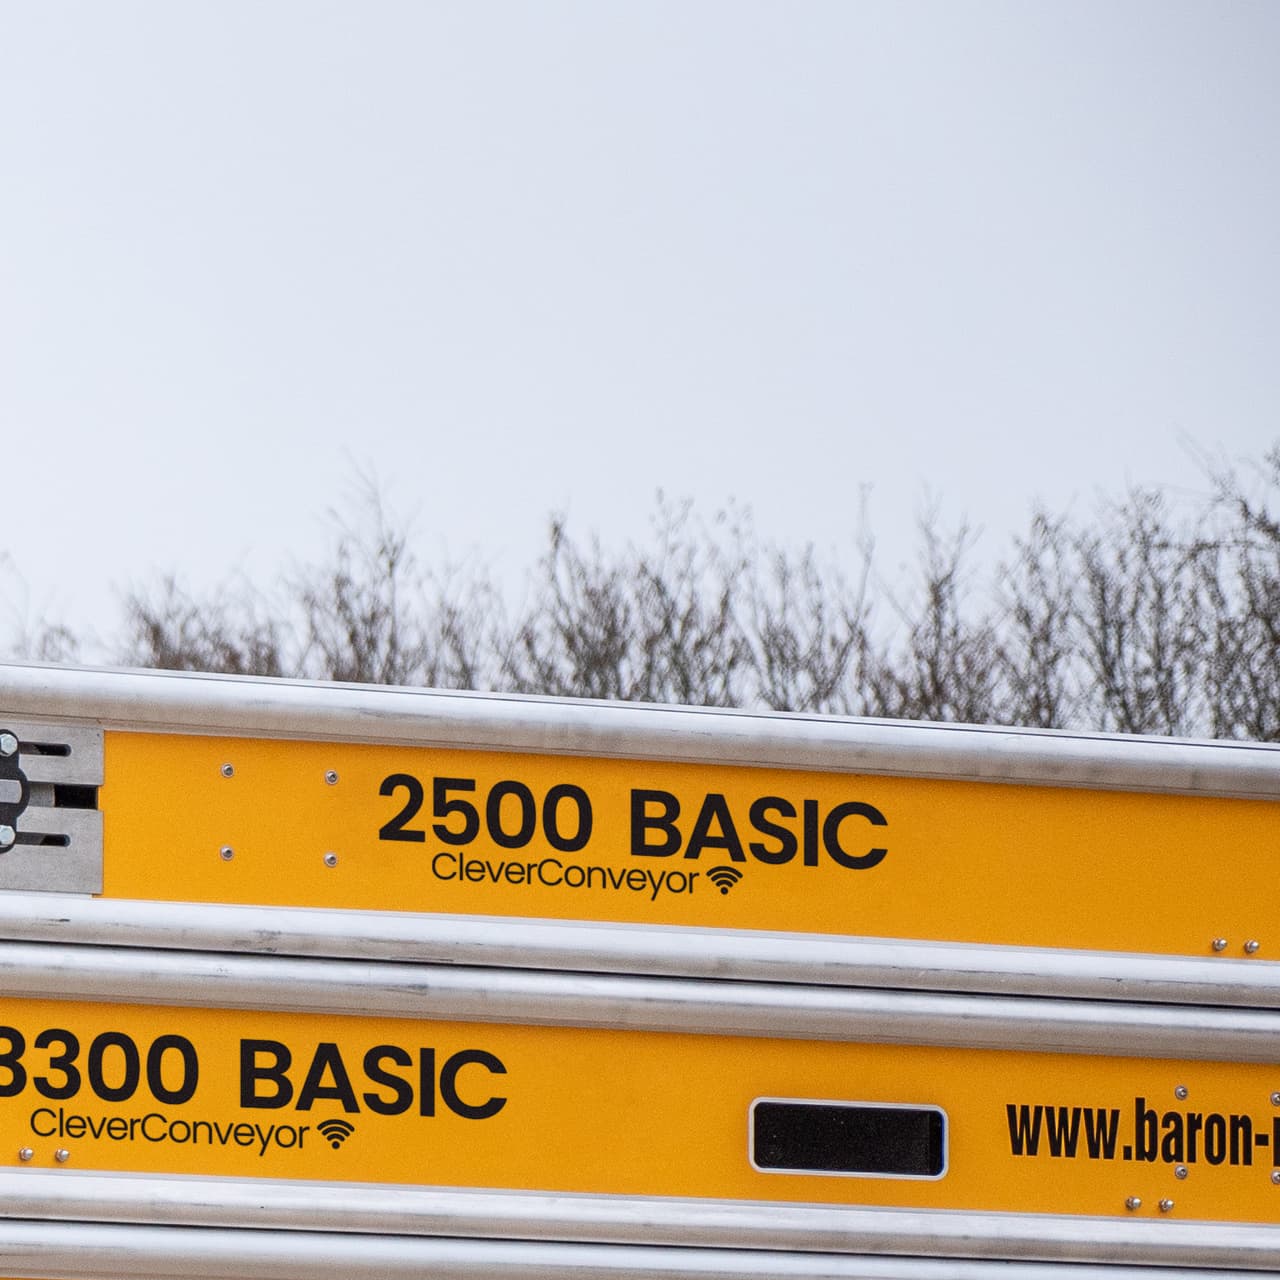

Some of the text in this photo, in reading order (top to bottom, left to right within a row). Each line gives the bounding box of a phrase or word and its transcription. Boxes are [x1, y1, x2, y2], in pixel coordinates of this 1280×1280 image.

[378, 773, 888, 870] 2500 BASIC
[431, 852, 700, 901] CleverConveyor
[240, 1038, 508, 1120] BASIC
[30, 1107, 310, 1157] CleverConveyor
